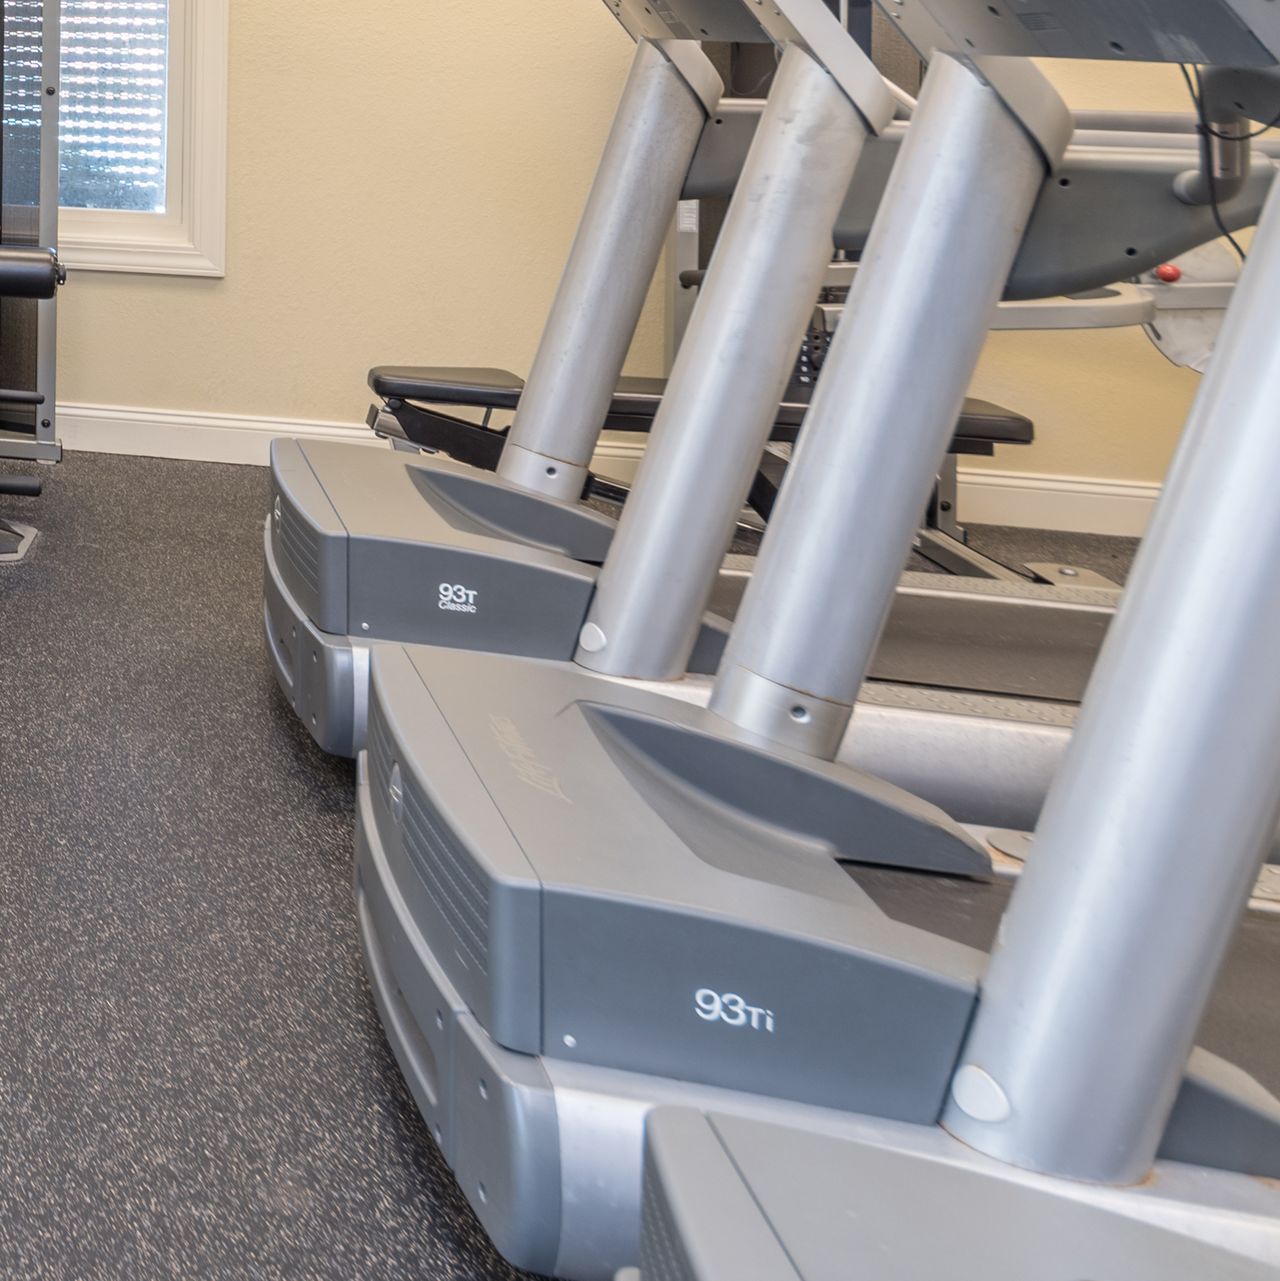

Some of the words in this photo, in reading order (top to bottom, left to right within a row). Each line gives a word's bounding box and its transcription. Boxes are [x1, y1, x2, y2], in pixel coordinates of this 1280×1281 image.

[439, 582, 478, 604] 93T
[438, 599, 477, 613] Classic
[694, 987, 775, 1033] 93Ti
